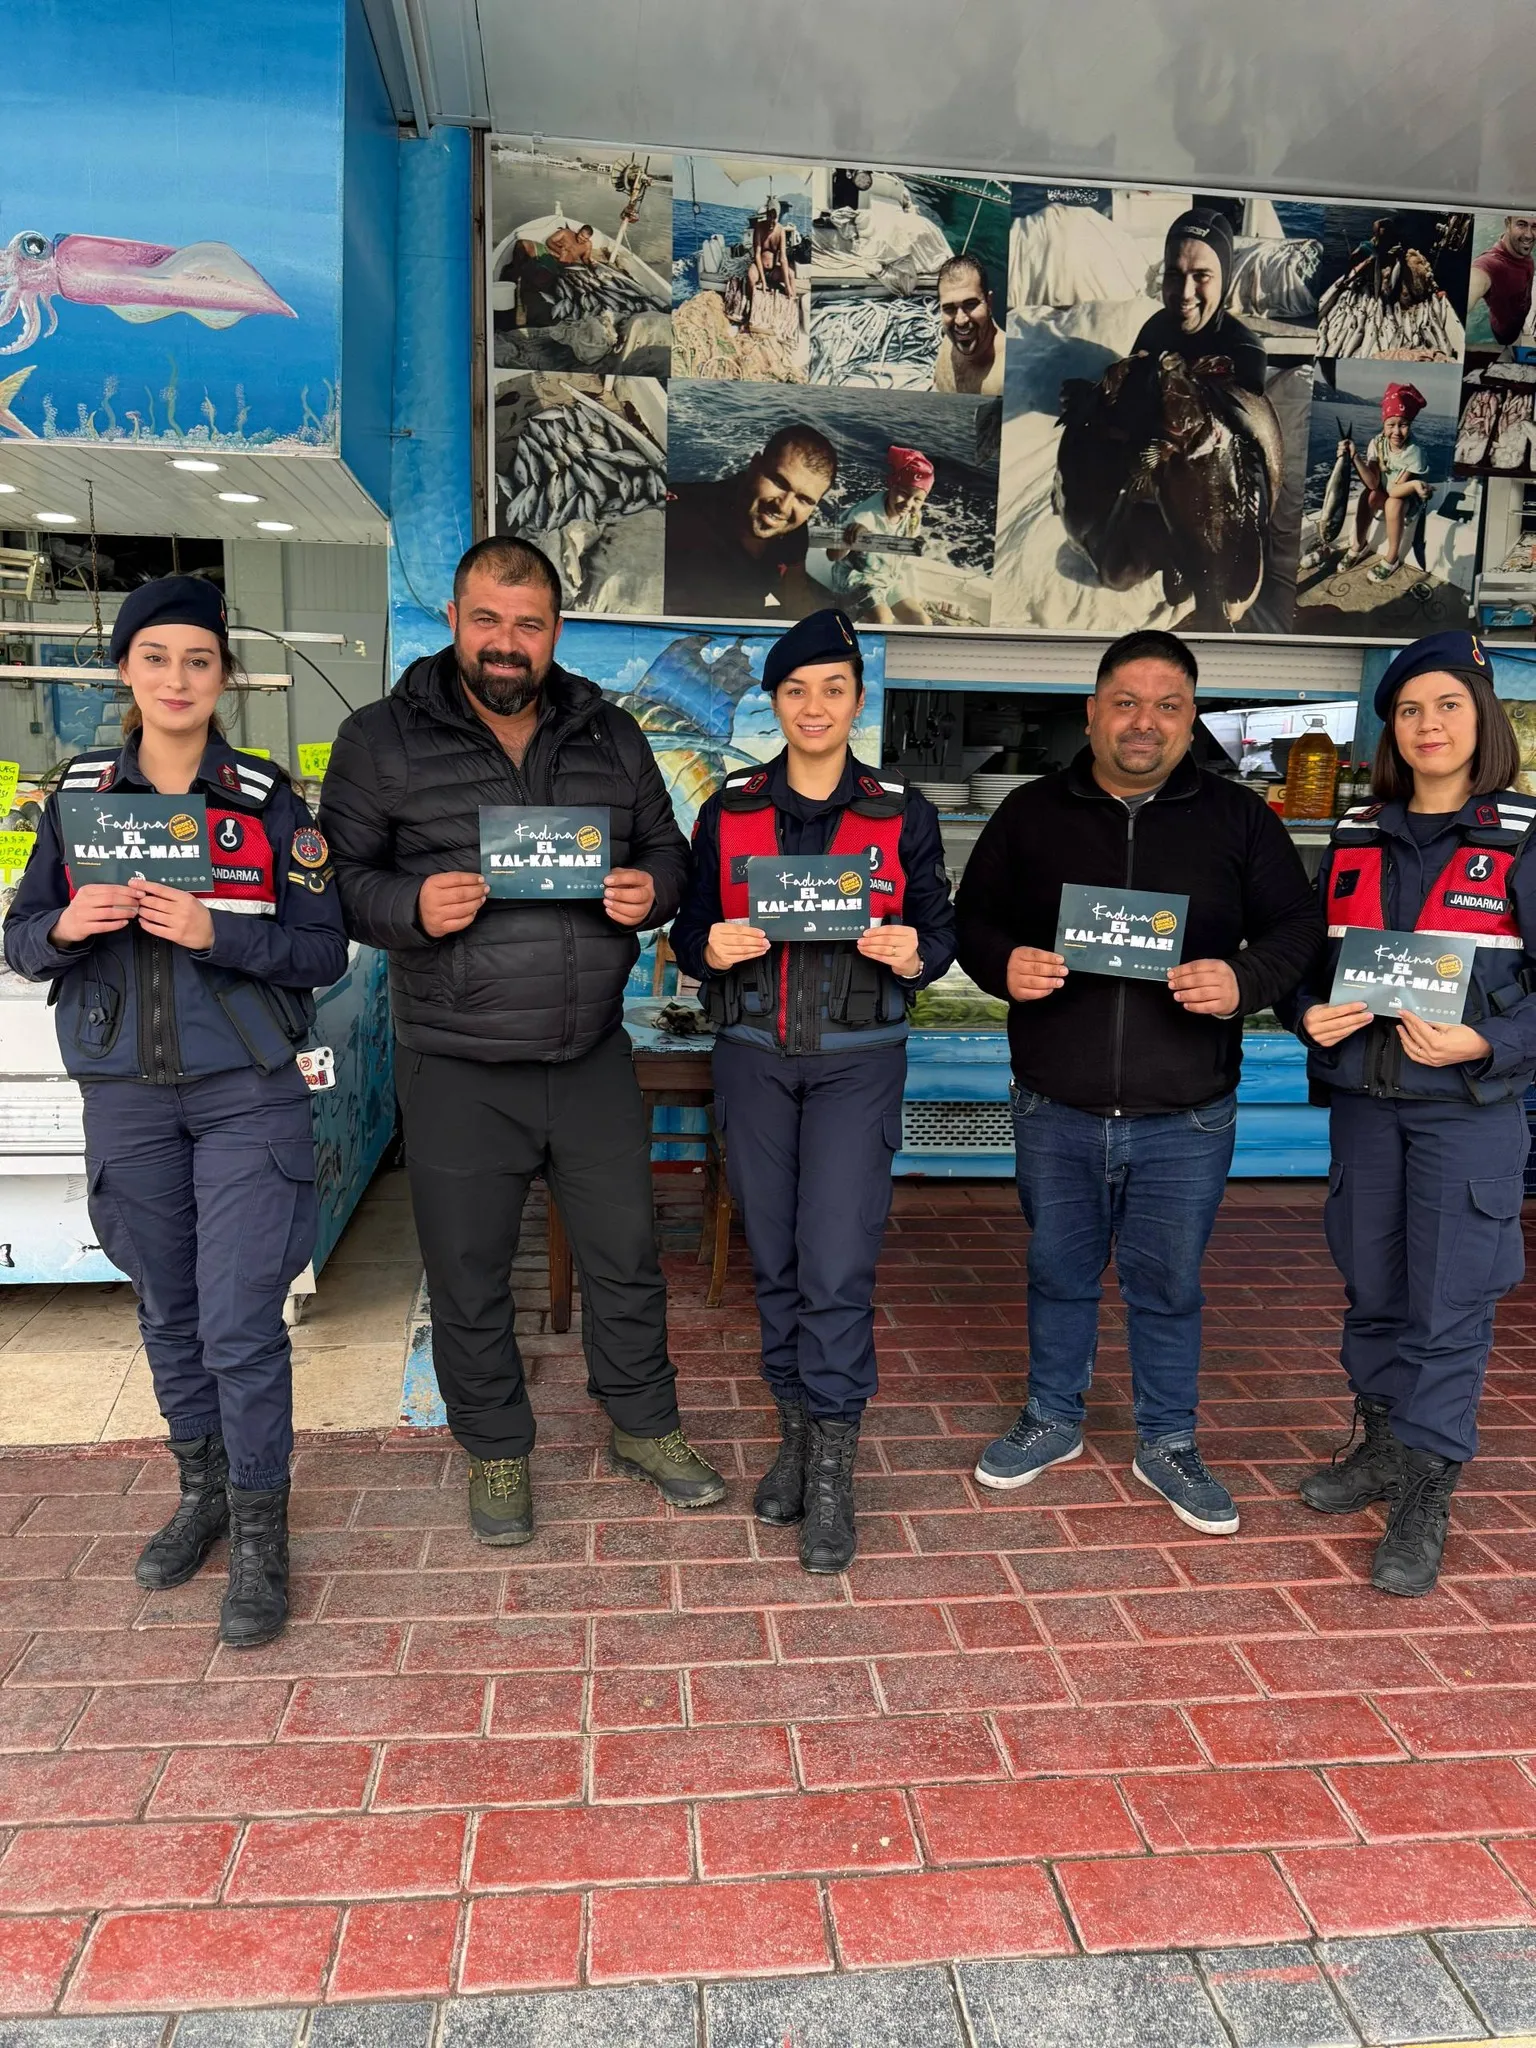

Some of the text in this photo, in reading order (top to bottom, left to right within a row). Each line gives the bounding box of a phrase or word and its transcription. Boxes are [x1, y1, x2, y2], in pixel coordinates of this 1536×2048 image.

[123, 831, 146, 844] EL
[74, 845, 200, 859] KAL-KA-MAZ!
[537, 841, 556, 853] EL
[490, 854, 601, 867] KAL-KA-MAZ!
[800, 887, 818, 899] EL
[757, 898, 862, 913] KAL-KA-MAZ!
[1450, 895, 1504, 912] JANDARMA
[1110, 920, 1130, 934] EL
[1064, 928, 1174, 951] KAL-KA-MAZ!
[1392, 962, 1413, 976] EL
[1343, 968, 1460, 995] KAL-KA-MAZ!
